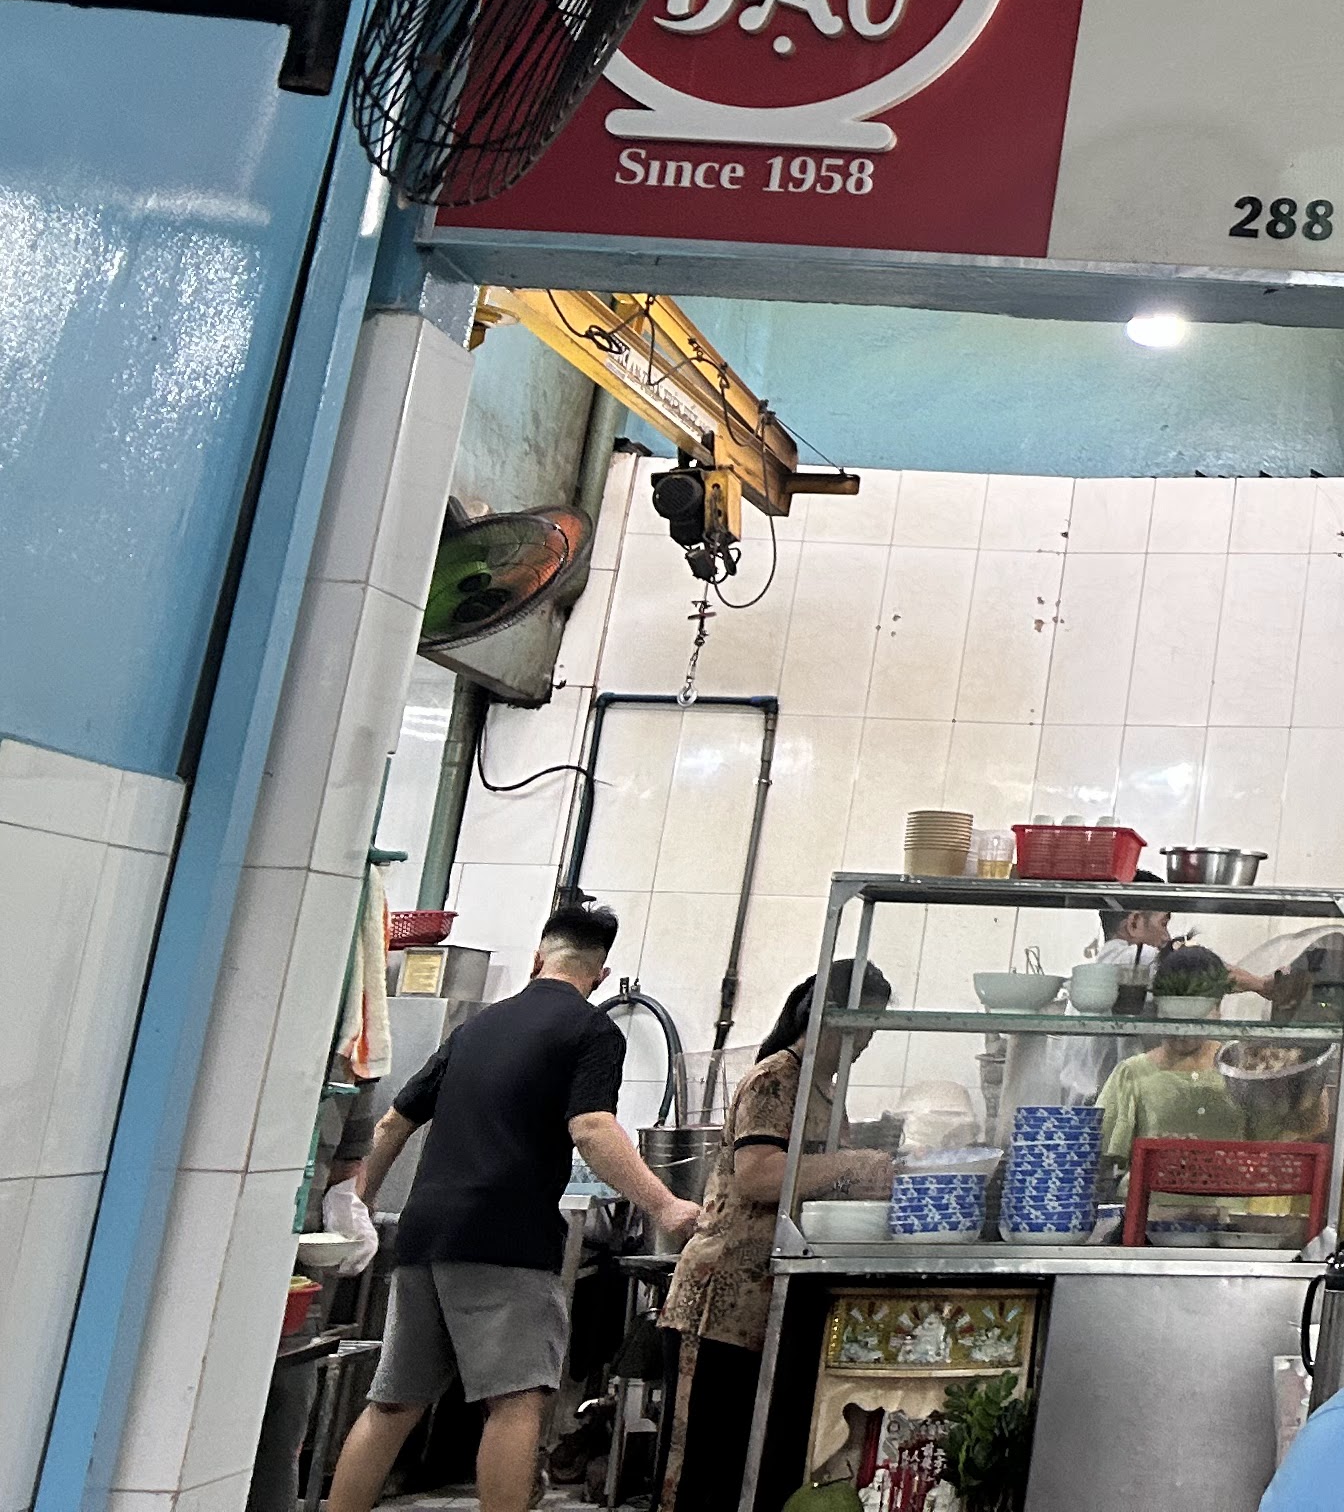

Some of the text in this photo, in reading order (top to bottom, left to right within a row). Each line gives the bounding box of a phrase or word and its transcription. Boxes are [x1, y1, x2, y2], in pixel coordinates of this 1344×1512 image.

[614, 148, 875, 195] Since 1958
[1228, 195, 1334, 241] 288
